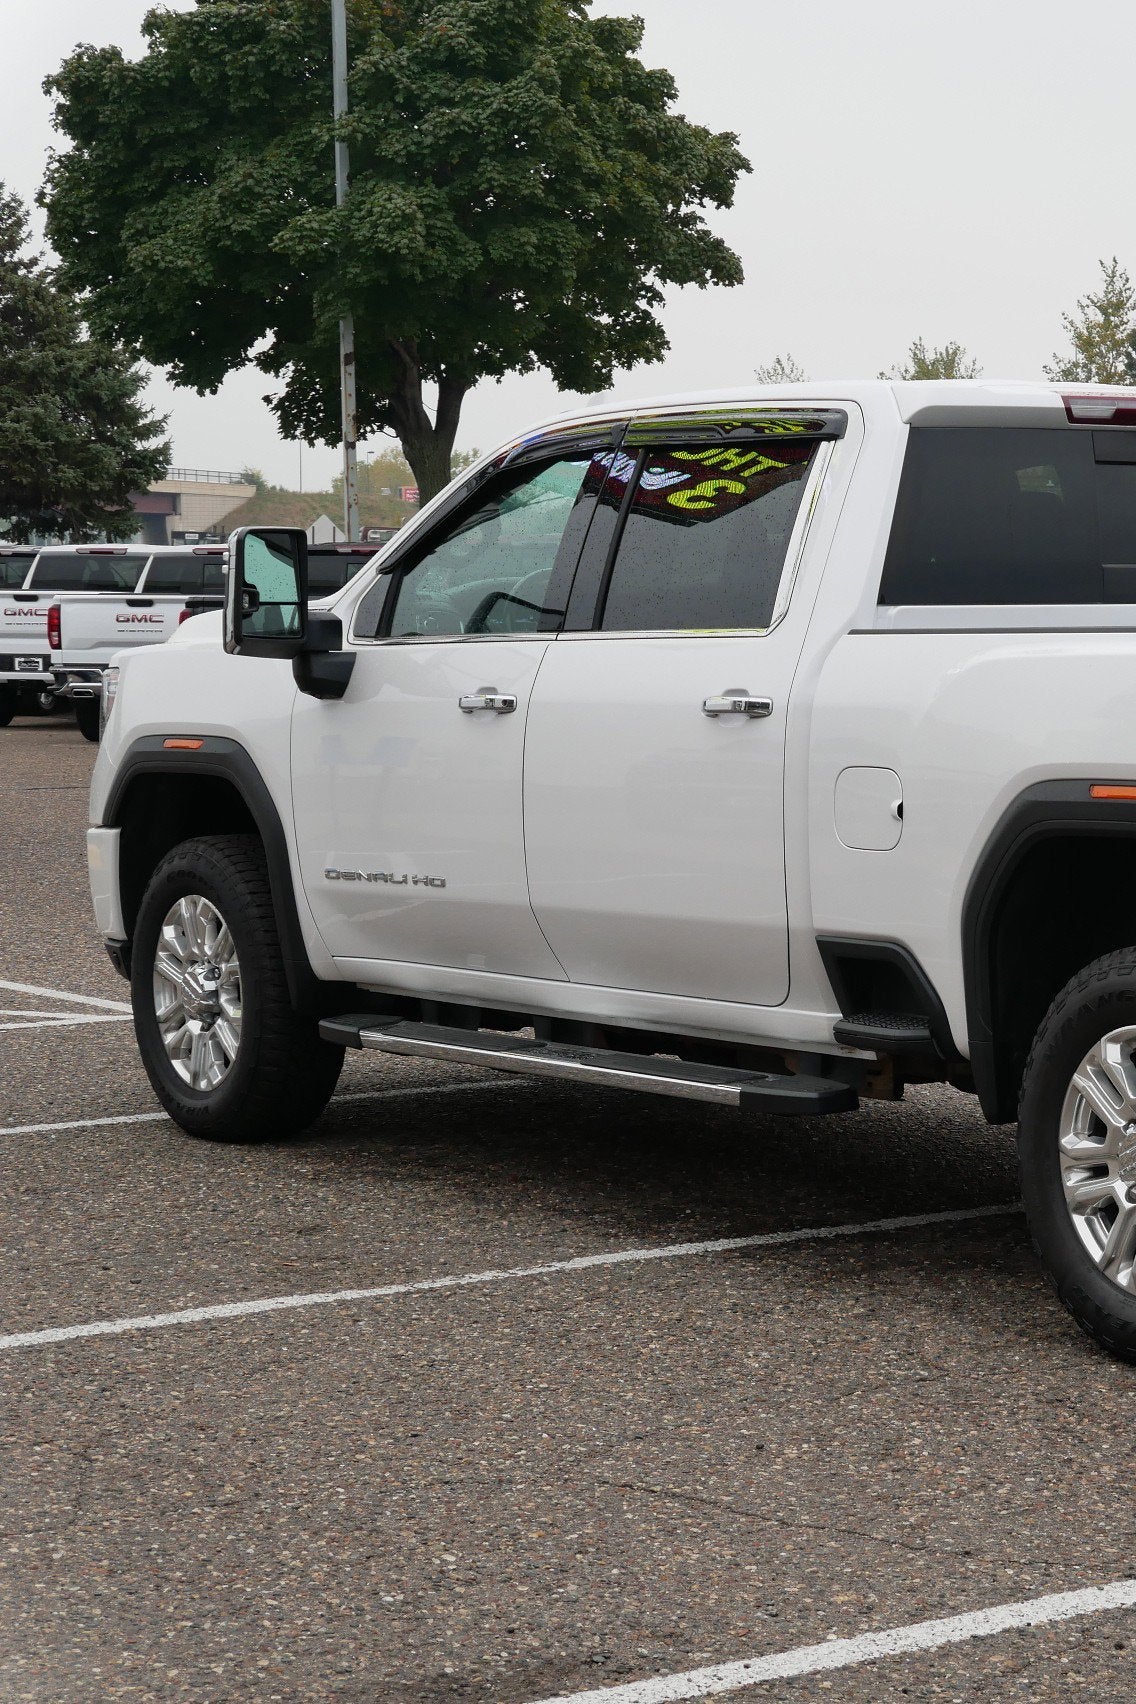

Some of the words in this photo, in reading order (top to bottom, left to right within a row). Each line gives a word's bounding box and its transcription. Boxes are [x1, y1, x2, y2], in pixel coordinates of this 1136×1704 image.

[4, 608, 48, 617] GMC
[115, 613, 165, 624] GMC
[324, 868, 408, 884] DENALI
[412, 874, 446, 888] HD
